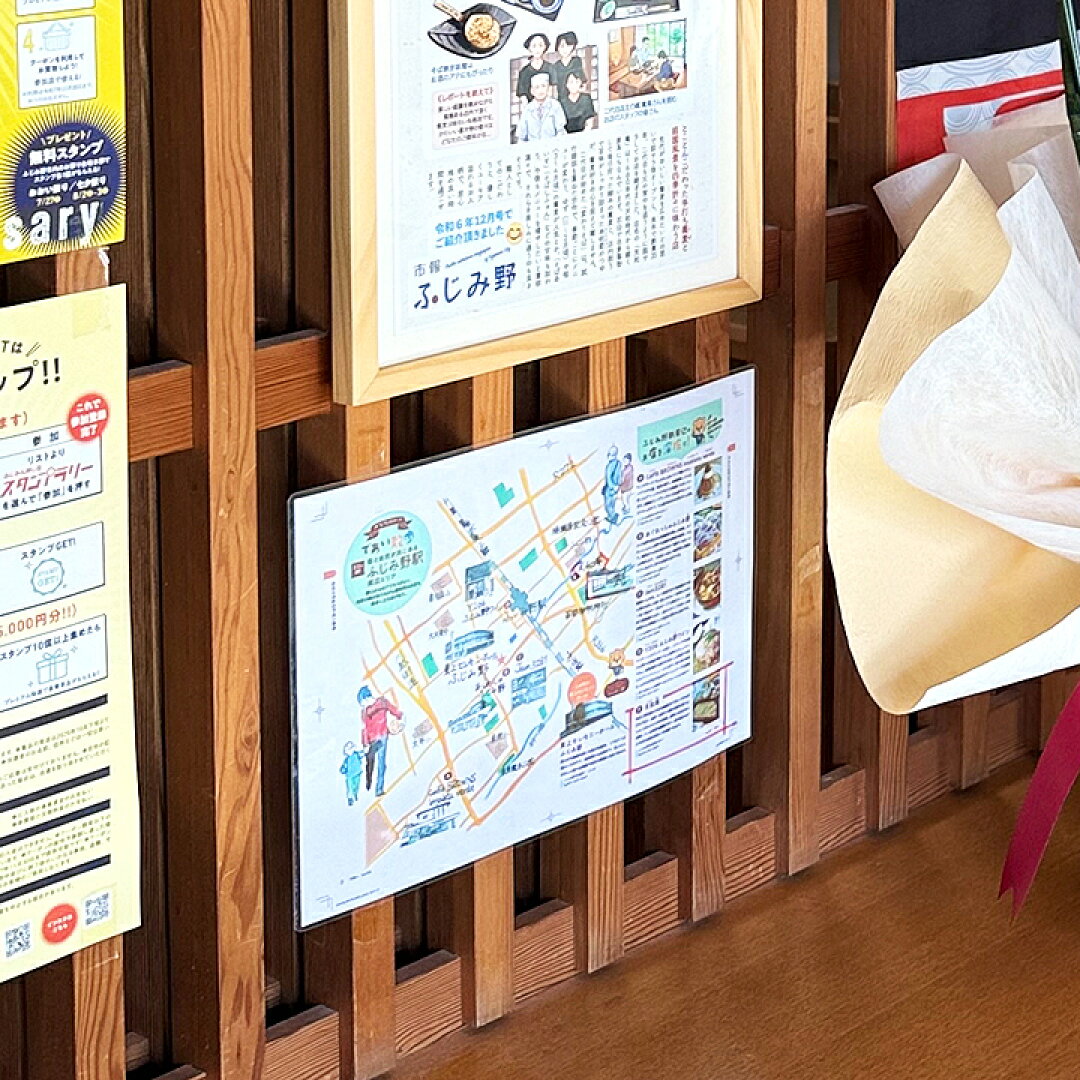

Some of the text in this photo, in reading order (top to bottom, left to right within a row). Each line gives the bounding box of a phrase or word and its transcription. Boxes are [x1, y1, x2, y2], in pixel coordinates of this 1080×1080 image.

[22, 28, 34, 54] 4
[411, 262, 517, 309] ふじみ野
